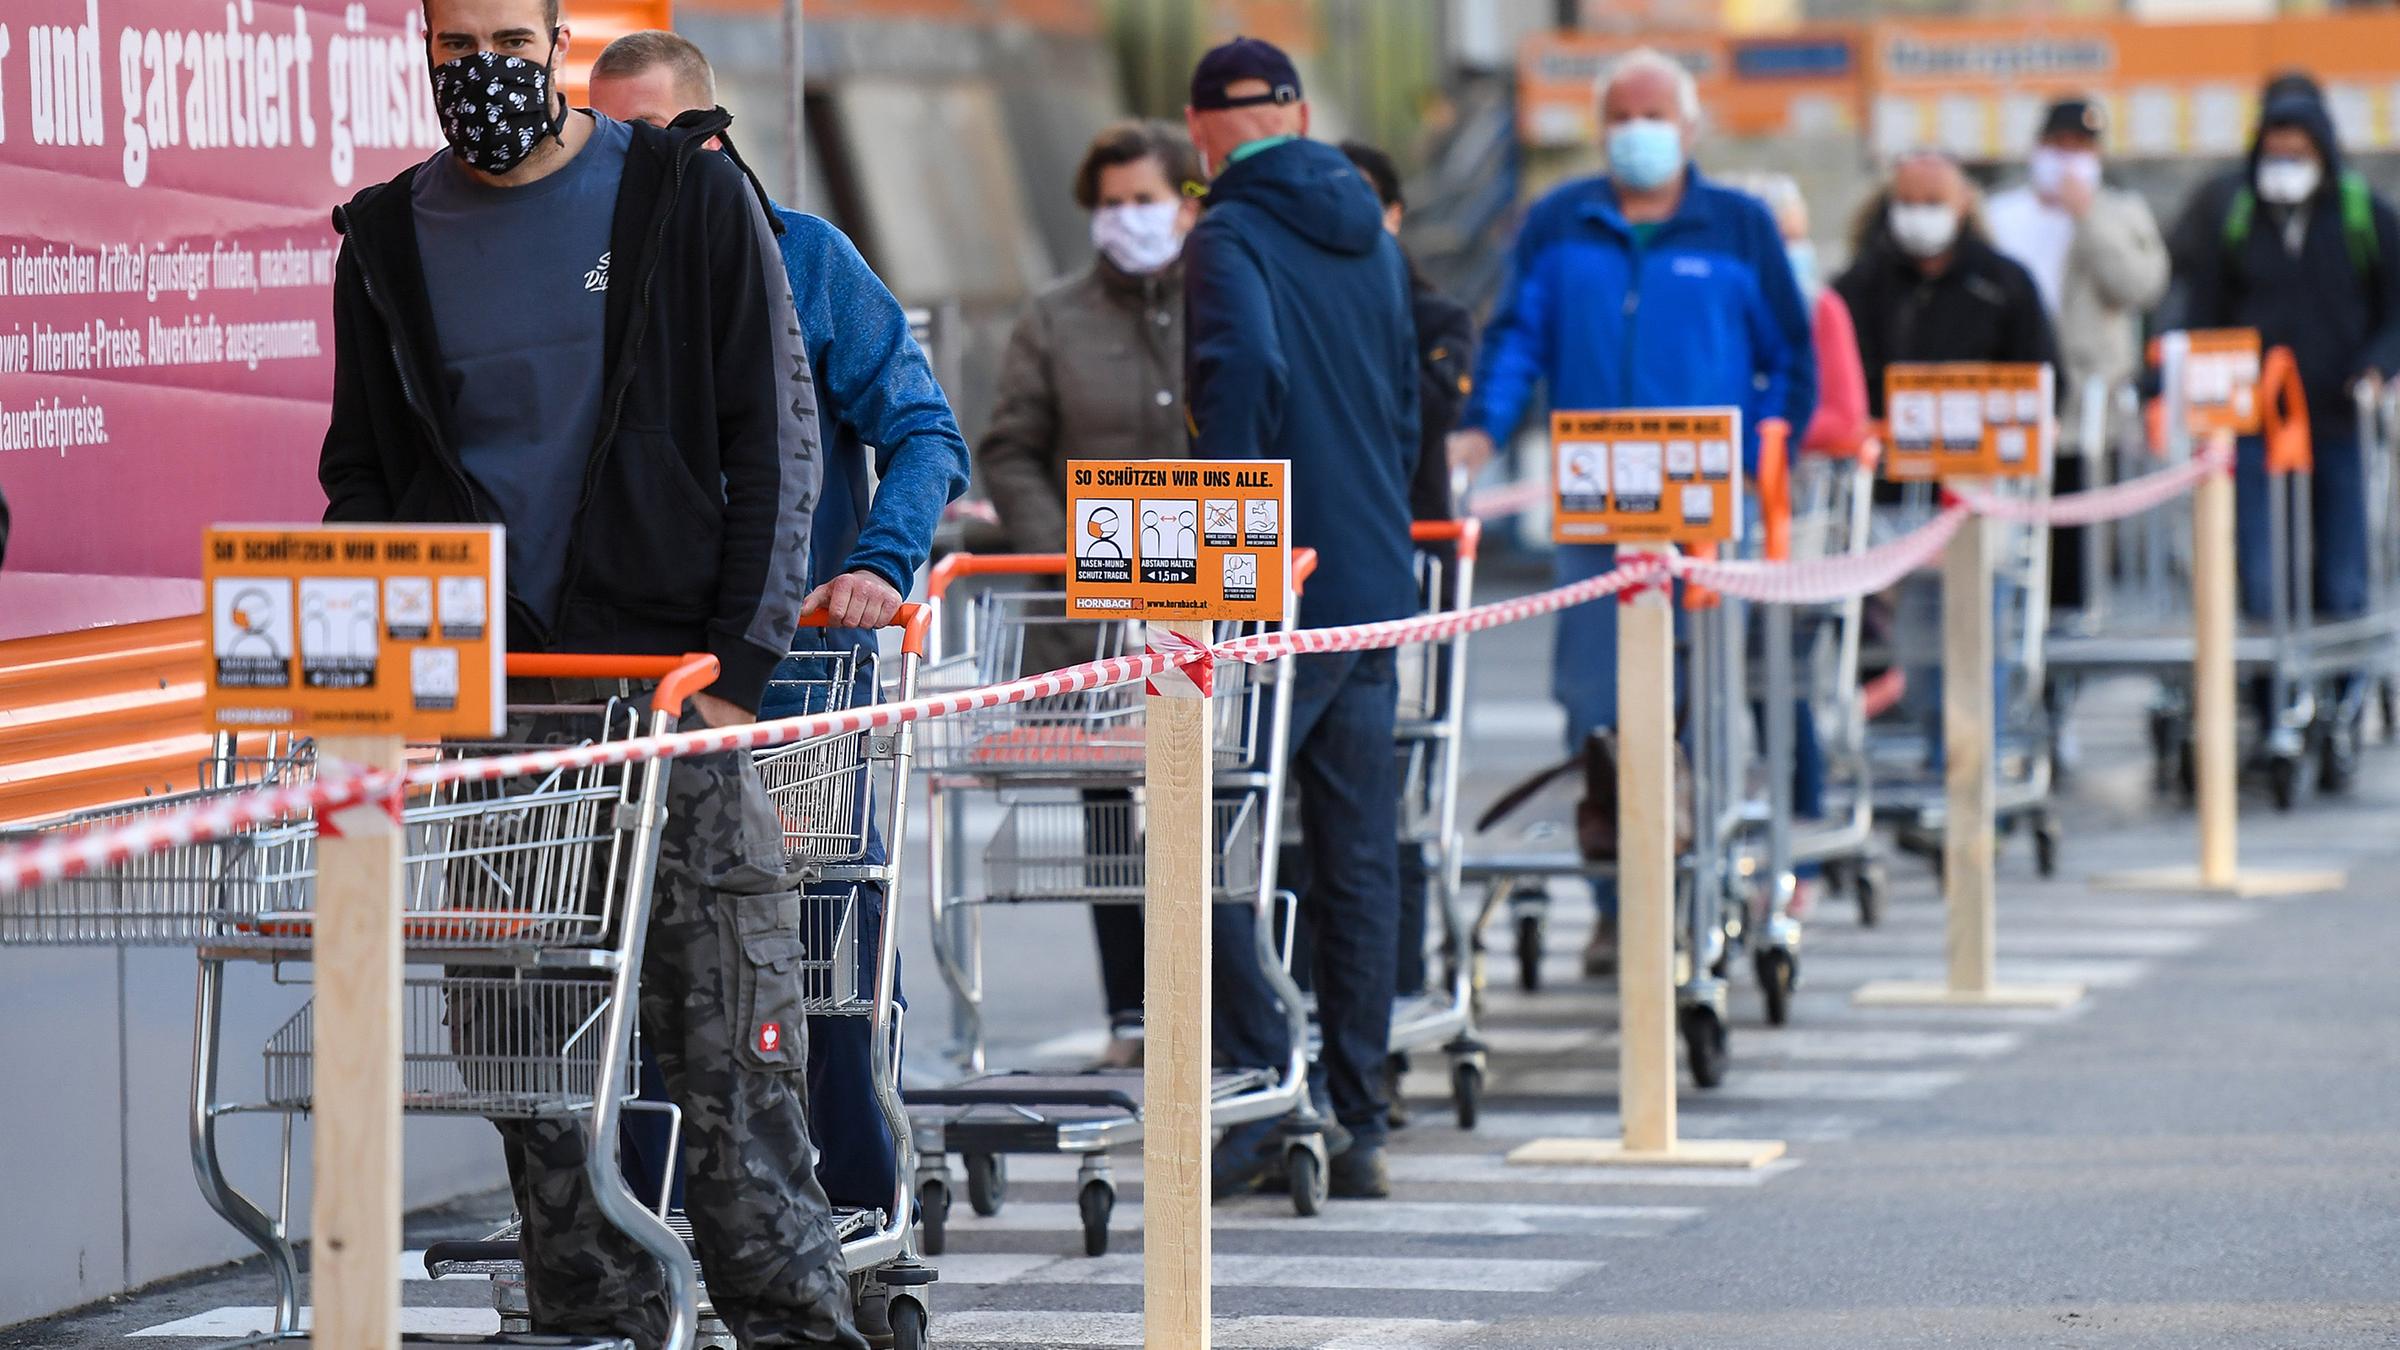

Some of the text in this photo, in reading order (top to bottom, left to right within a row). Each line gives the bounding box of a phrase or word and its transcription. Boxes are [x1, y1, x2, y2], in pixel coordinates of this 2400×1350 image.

[28, 0, 103, 147] und
[119, 0, 316, 188] garantiert
[328, 2, 437, 188] günsti
[12, 244, 95, 296] identischen
[99, 243, 145, 293] Artikel
[147, 241, 210, 302] günstiger
[213, 240, 258, 297] finden,
[260, 239, 310, 288] machen
[311, 237, 332, 286] wir
[32, 317, 145, 371] Internet-Preise.
[148, 313, 223, 366] Abverkäufe
[225, 320, 322, 371] ausgenommen.
[1075, 467, 1273, 487] SO SCHÜTZEN WIR UNS ALLE.
[1080, 559, 1128, 568] NASEN-MUND-
[1141, 559, 1195, 568] ABSTAND HALTEN.
[1078, 571, 1130, 580] SCHUTZ TRAGEN.
[1157, 570, 1179, 582] 1,5 m
[1076, 598, 1208, 609] HORNBACH www.hornbach.at
